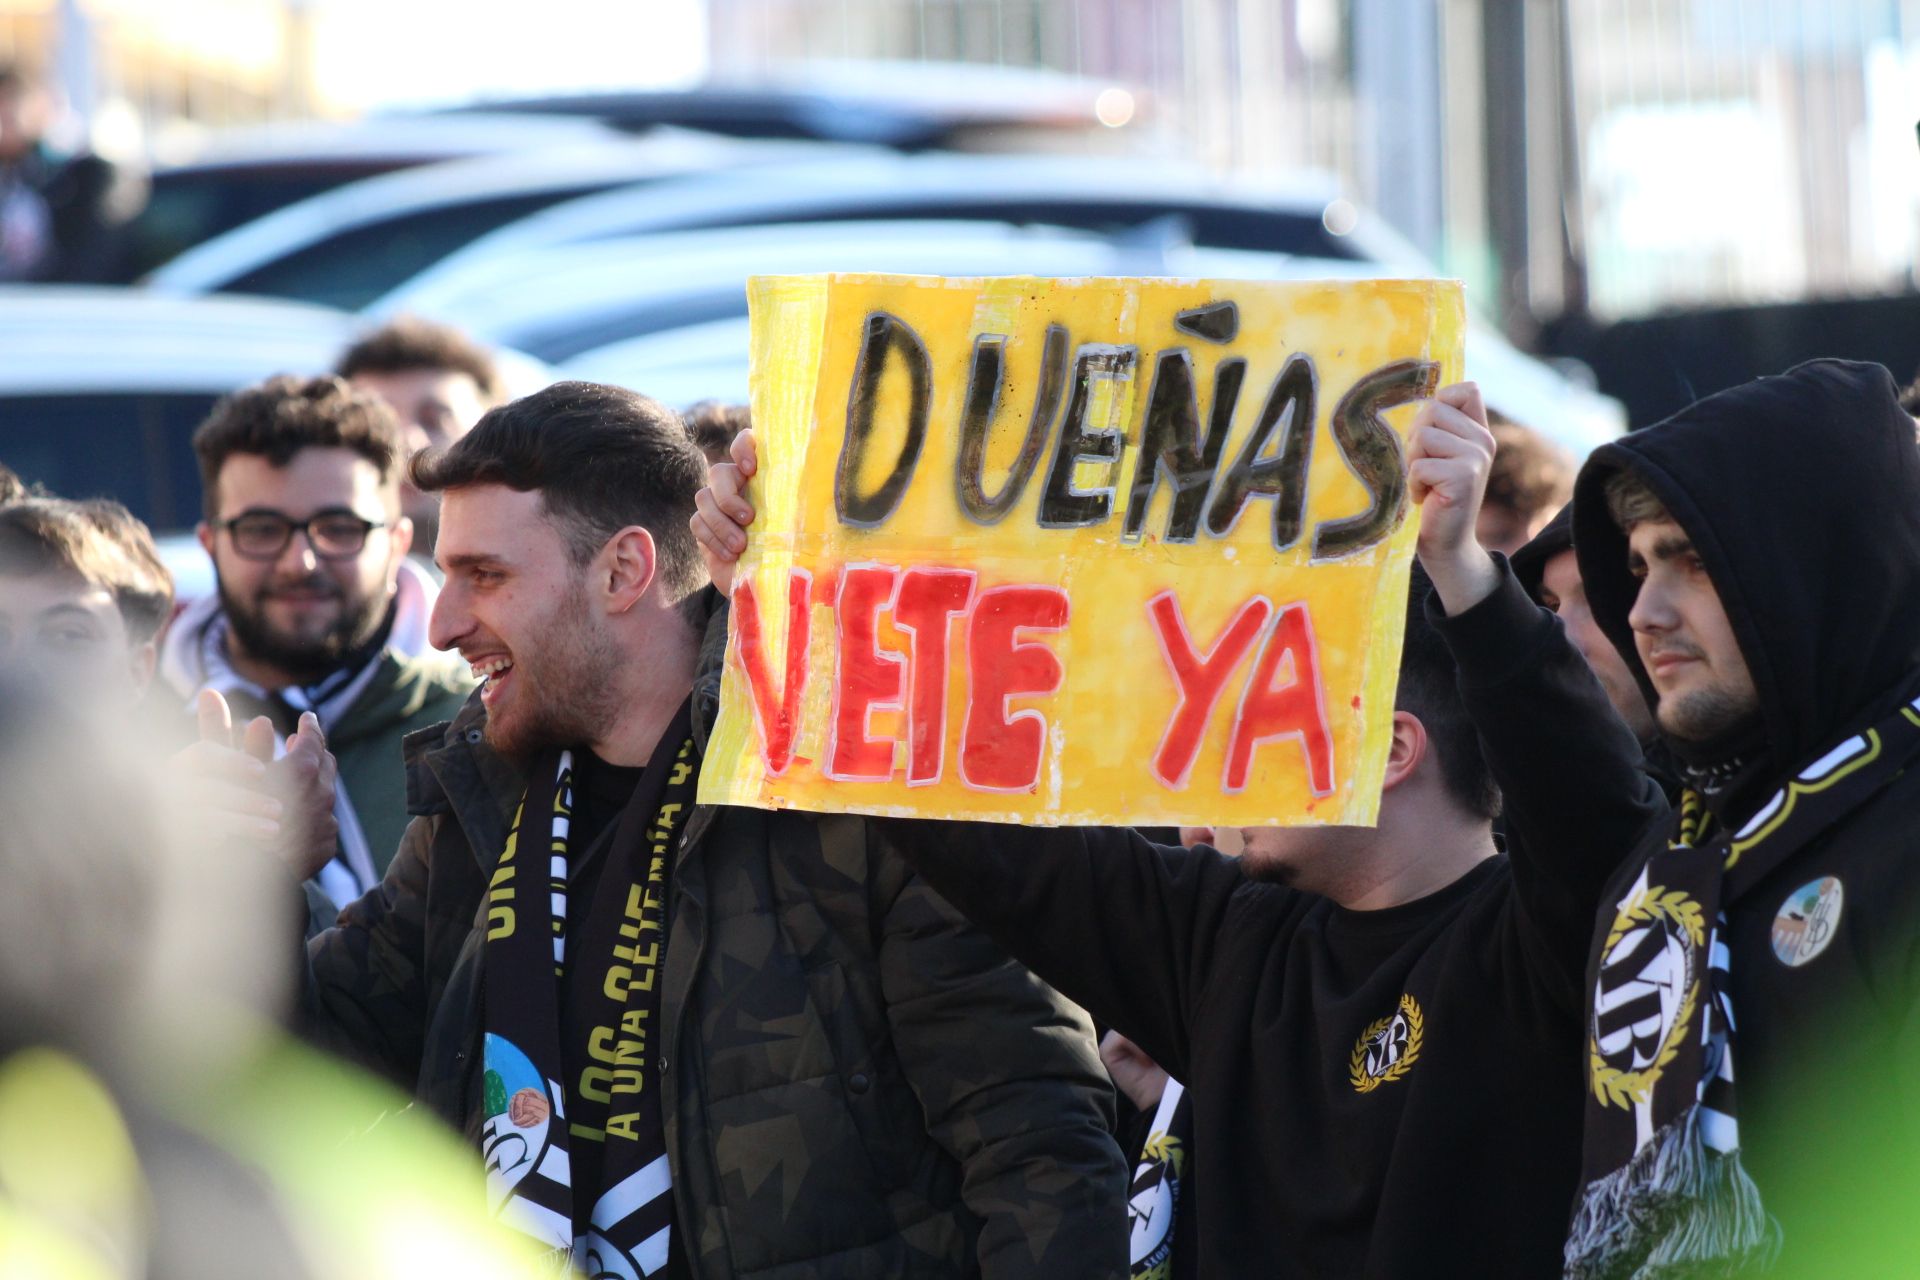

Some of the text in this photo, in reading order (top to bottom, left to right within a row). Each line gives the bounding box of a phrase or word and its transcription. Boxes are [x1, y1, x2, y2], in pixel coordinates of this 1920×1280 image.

[834, 301, 1441, 565] DUEÑAS
[731, 562, 1336, 797] VETE YA
[610, 1010, 649, 1094] UNA
